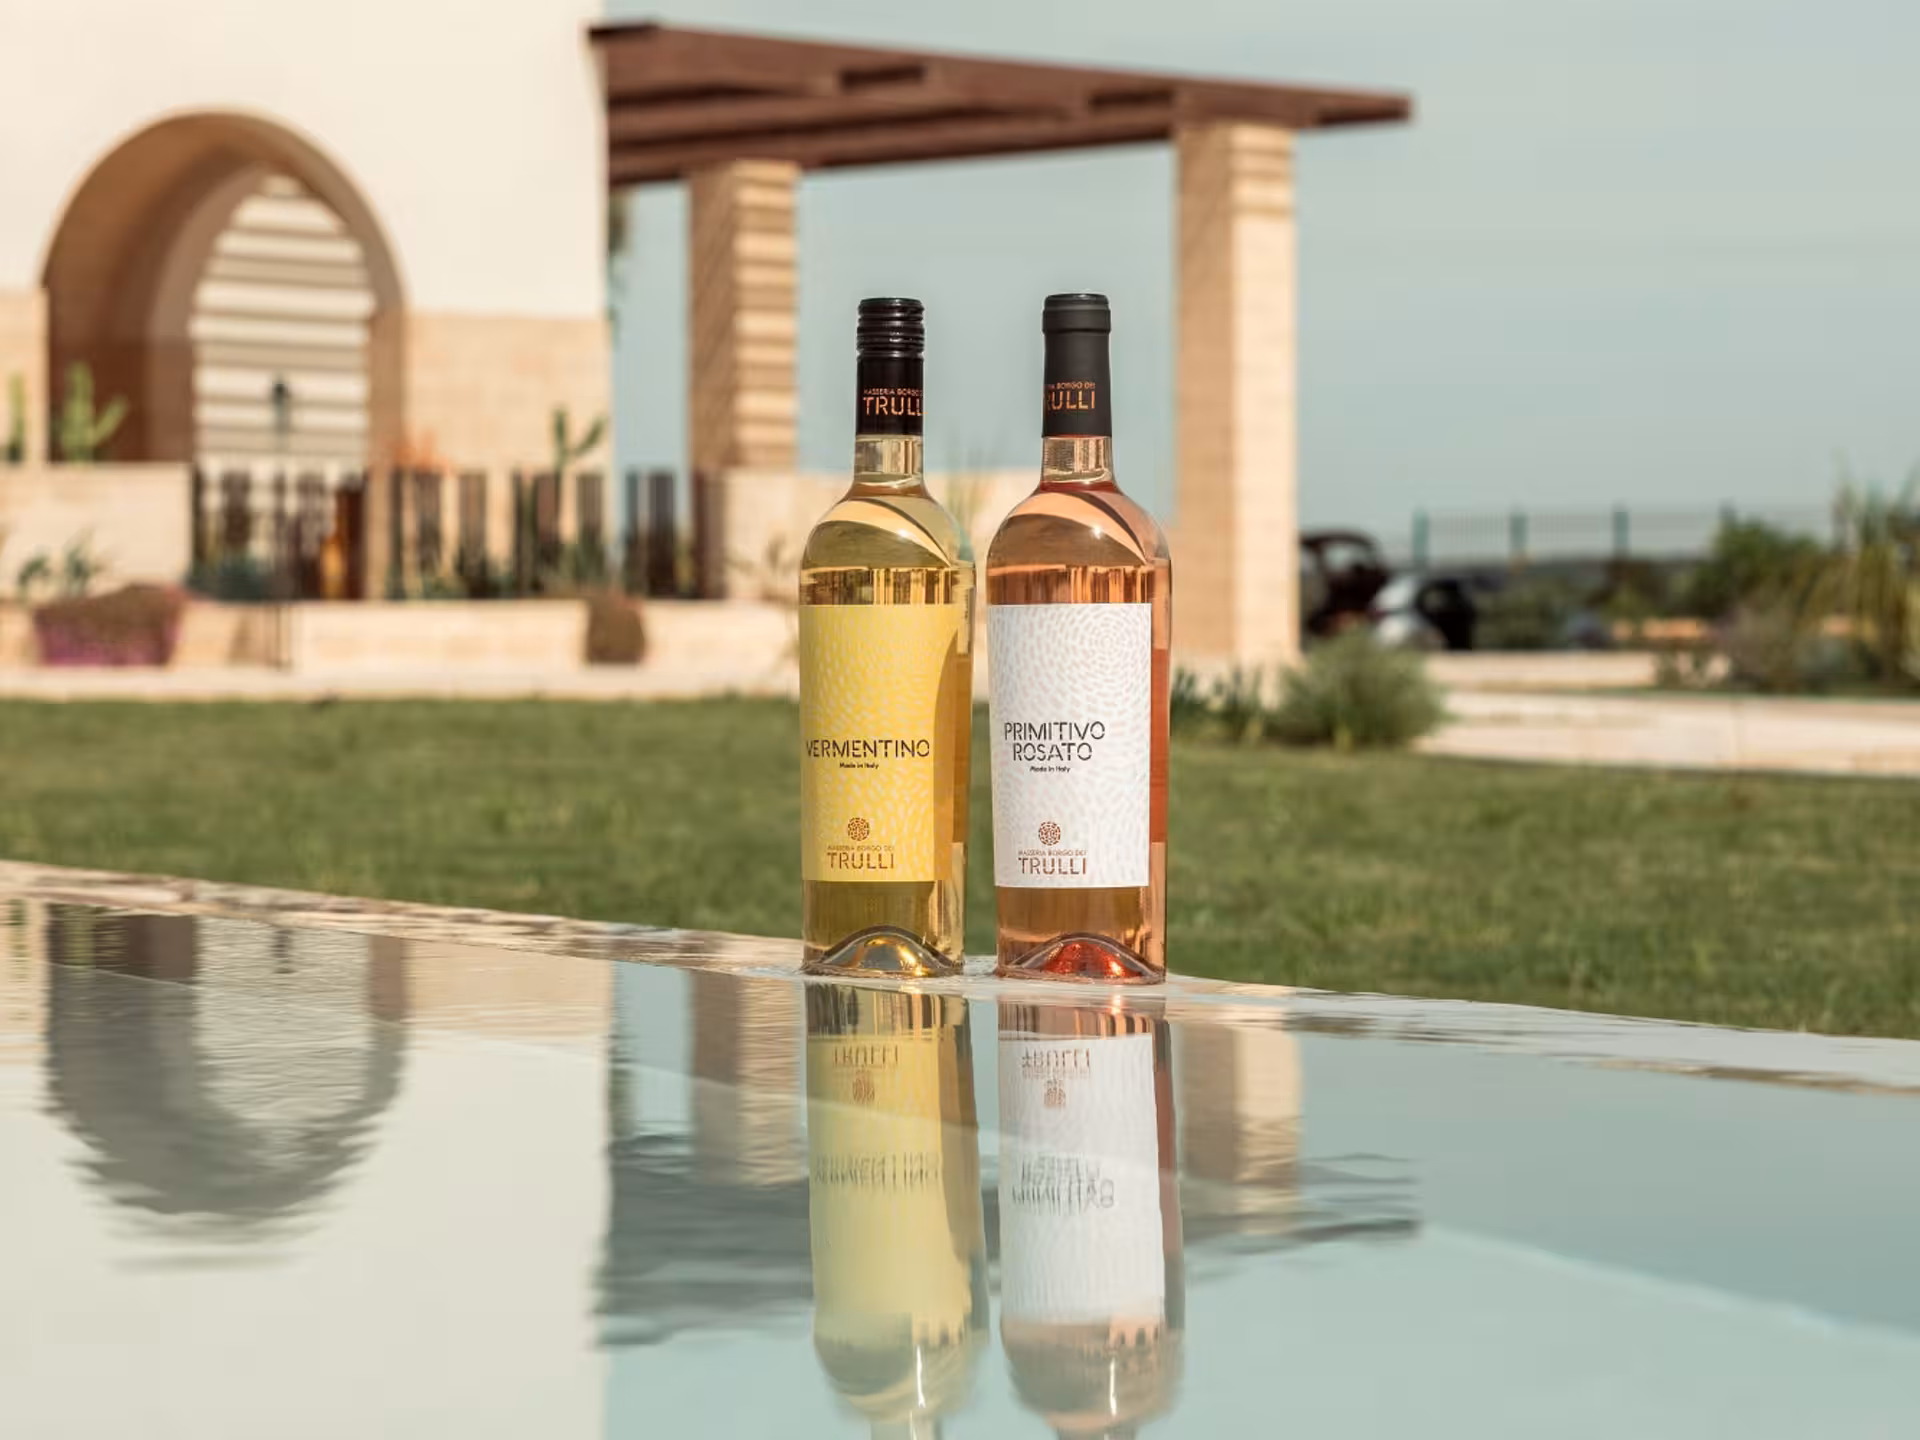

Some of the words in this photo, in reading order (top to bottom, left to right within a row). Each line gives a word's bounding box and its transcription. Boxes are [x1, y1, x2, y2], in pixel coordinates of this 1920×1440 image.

[1004, 721, 1105, 740] PRIMITIVO
[806, 739, 930, 758] VERMENTINO
[1013, 742, 1092, 761] ROSATO
[865, 762, 879, 770] Italy
[1056, 765, 1070, 773] Italy
[827, 852, 894, 869] TRULLI
[1018, 857, 1086, 875] TRULLI
